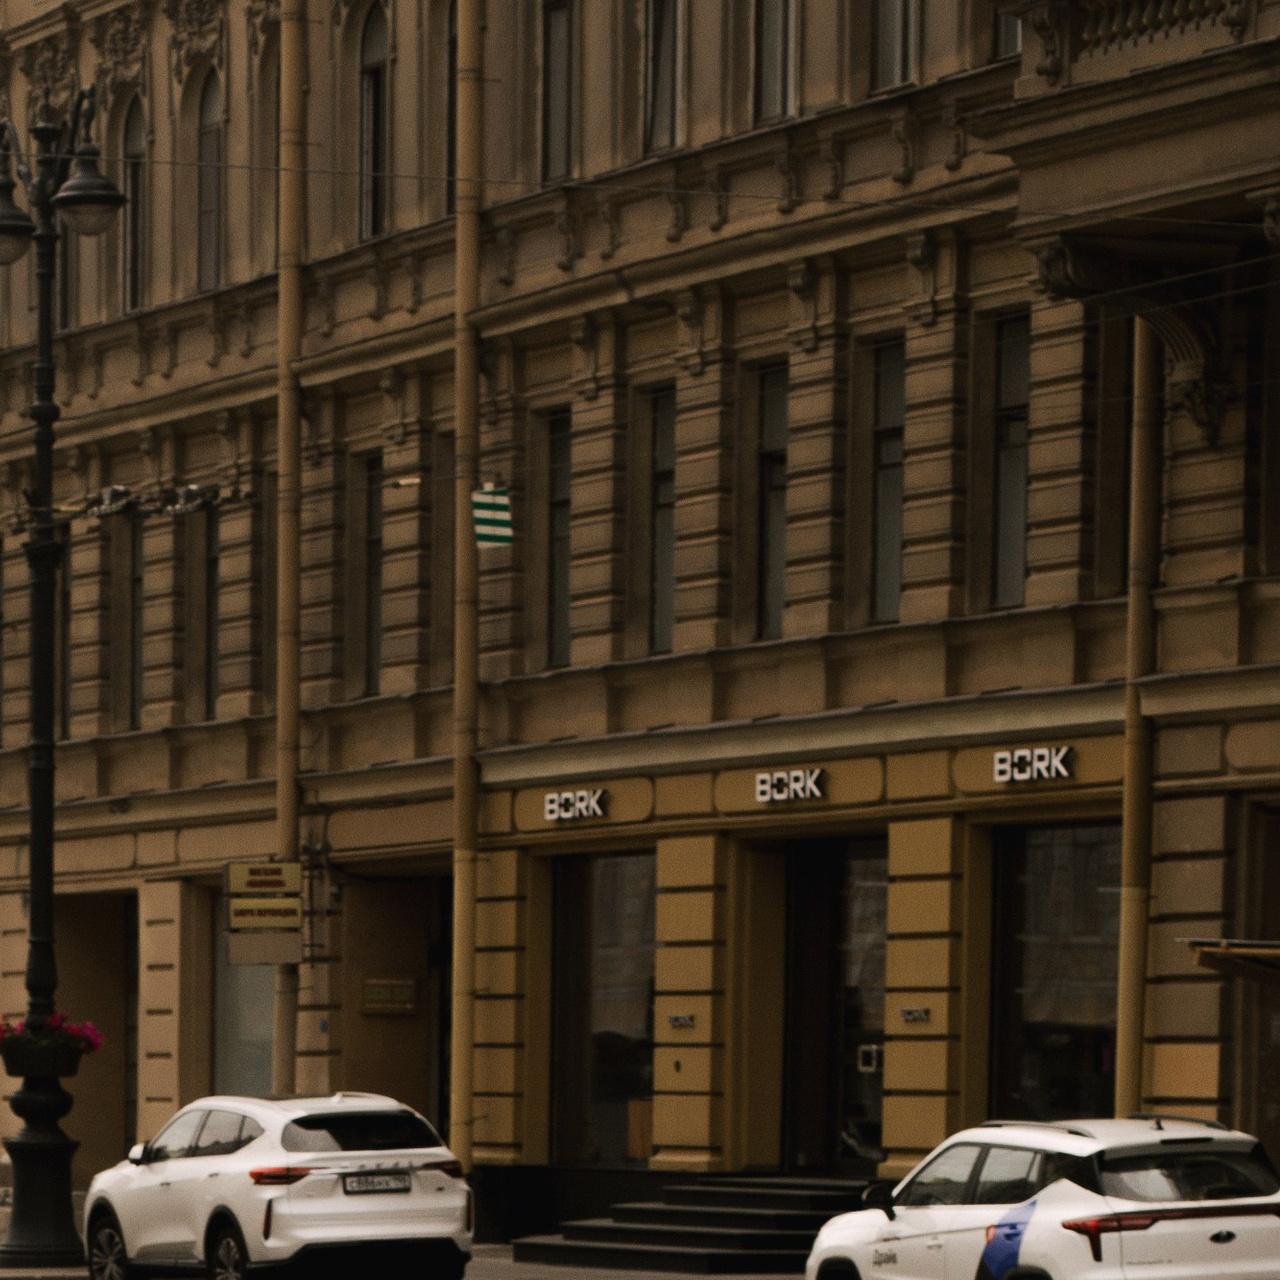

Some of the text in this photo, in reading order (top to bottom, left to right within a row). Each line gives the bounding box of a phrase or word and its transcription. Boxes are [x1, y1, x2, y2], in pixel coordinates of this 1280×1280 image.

[993, 746, 1070, 782] BORK
[755, 768, 823, 803] BORK
[543, 788, 605, 822] BORK
